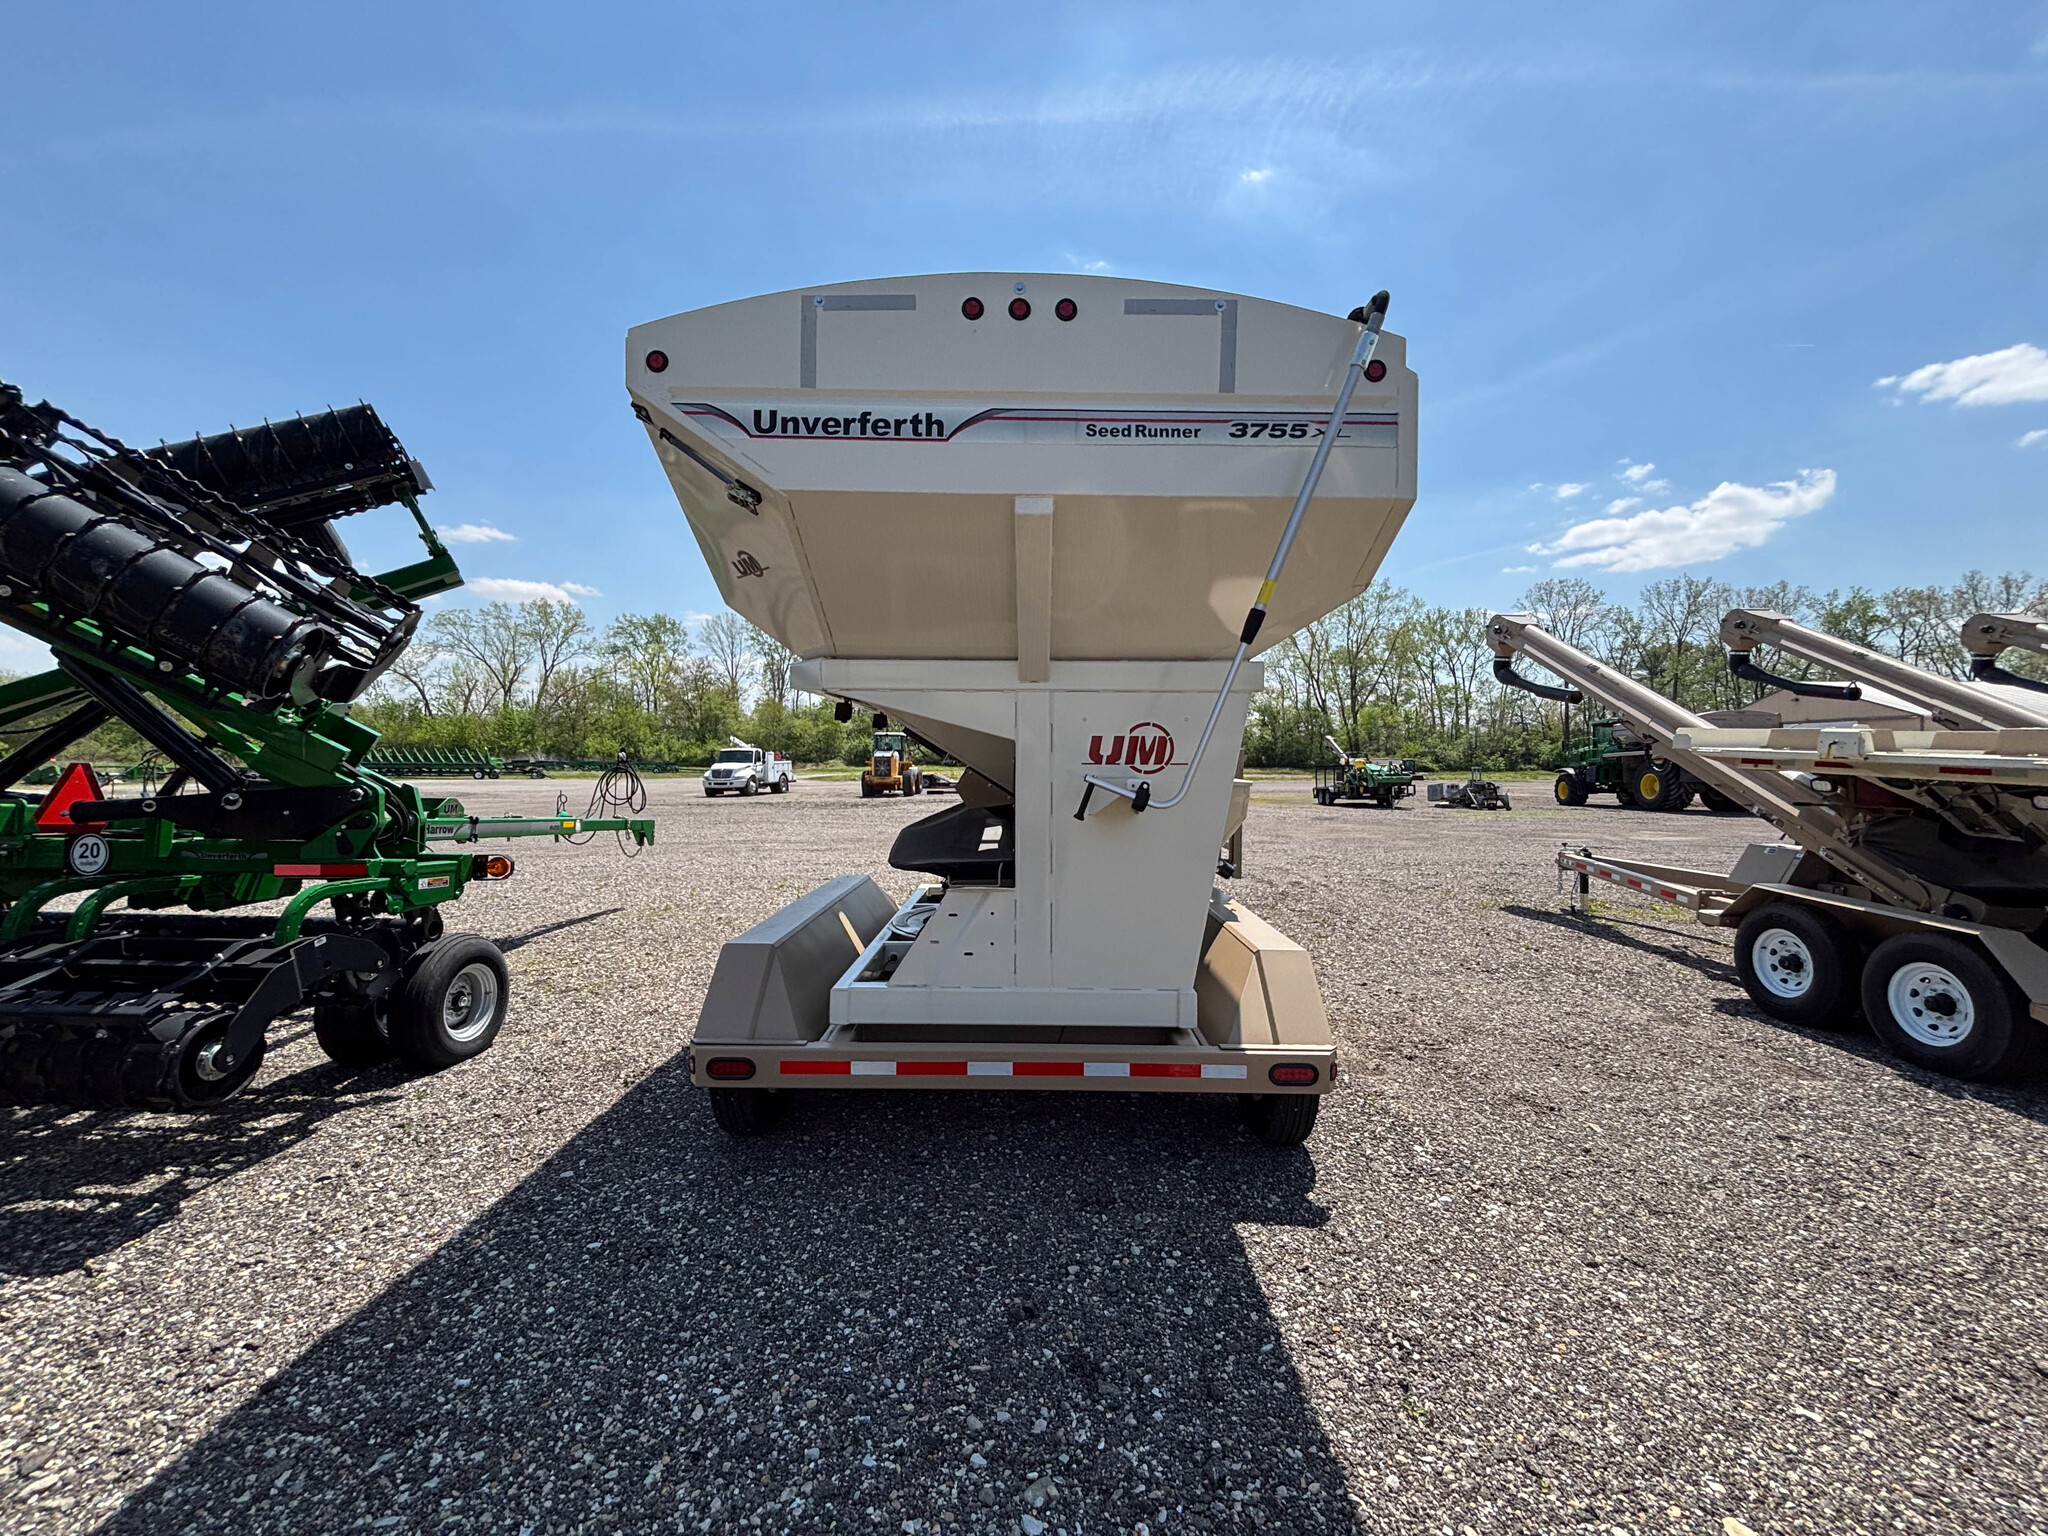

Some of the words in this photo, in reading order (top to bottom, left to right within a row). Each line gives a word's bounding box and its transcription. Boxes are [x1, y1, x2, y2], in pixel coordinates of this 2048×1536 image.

[753, 409, 945, 438] Unverferth
[1088, 735, 1169, 766] UM
[79, 842, 100, 859] 20
